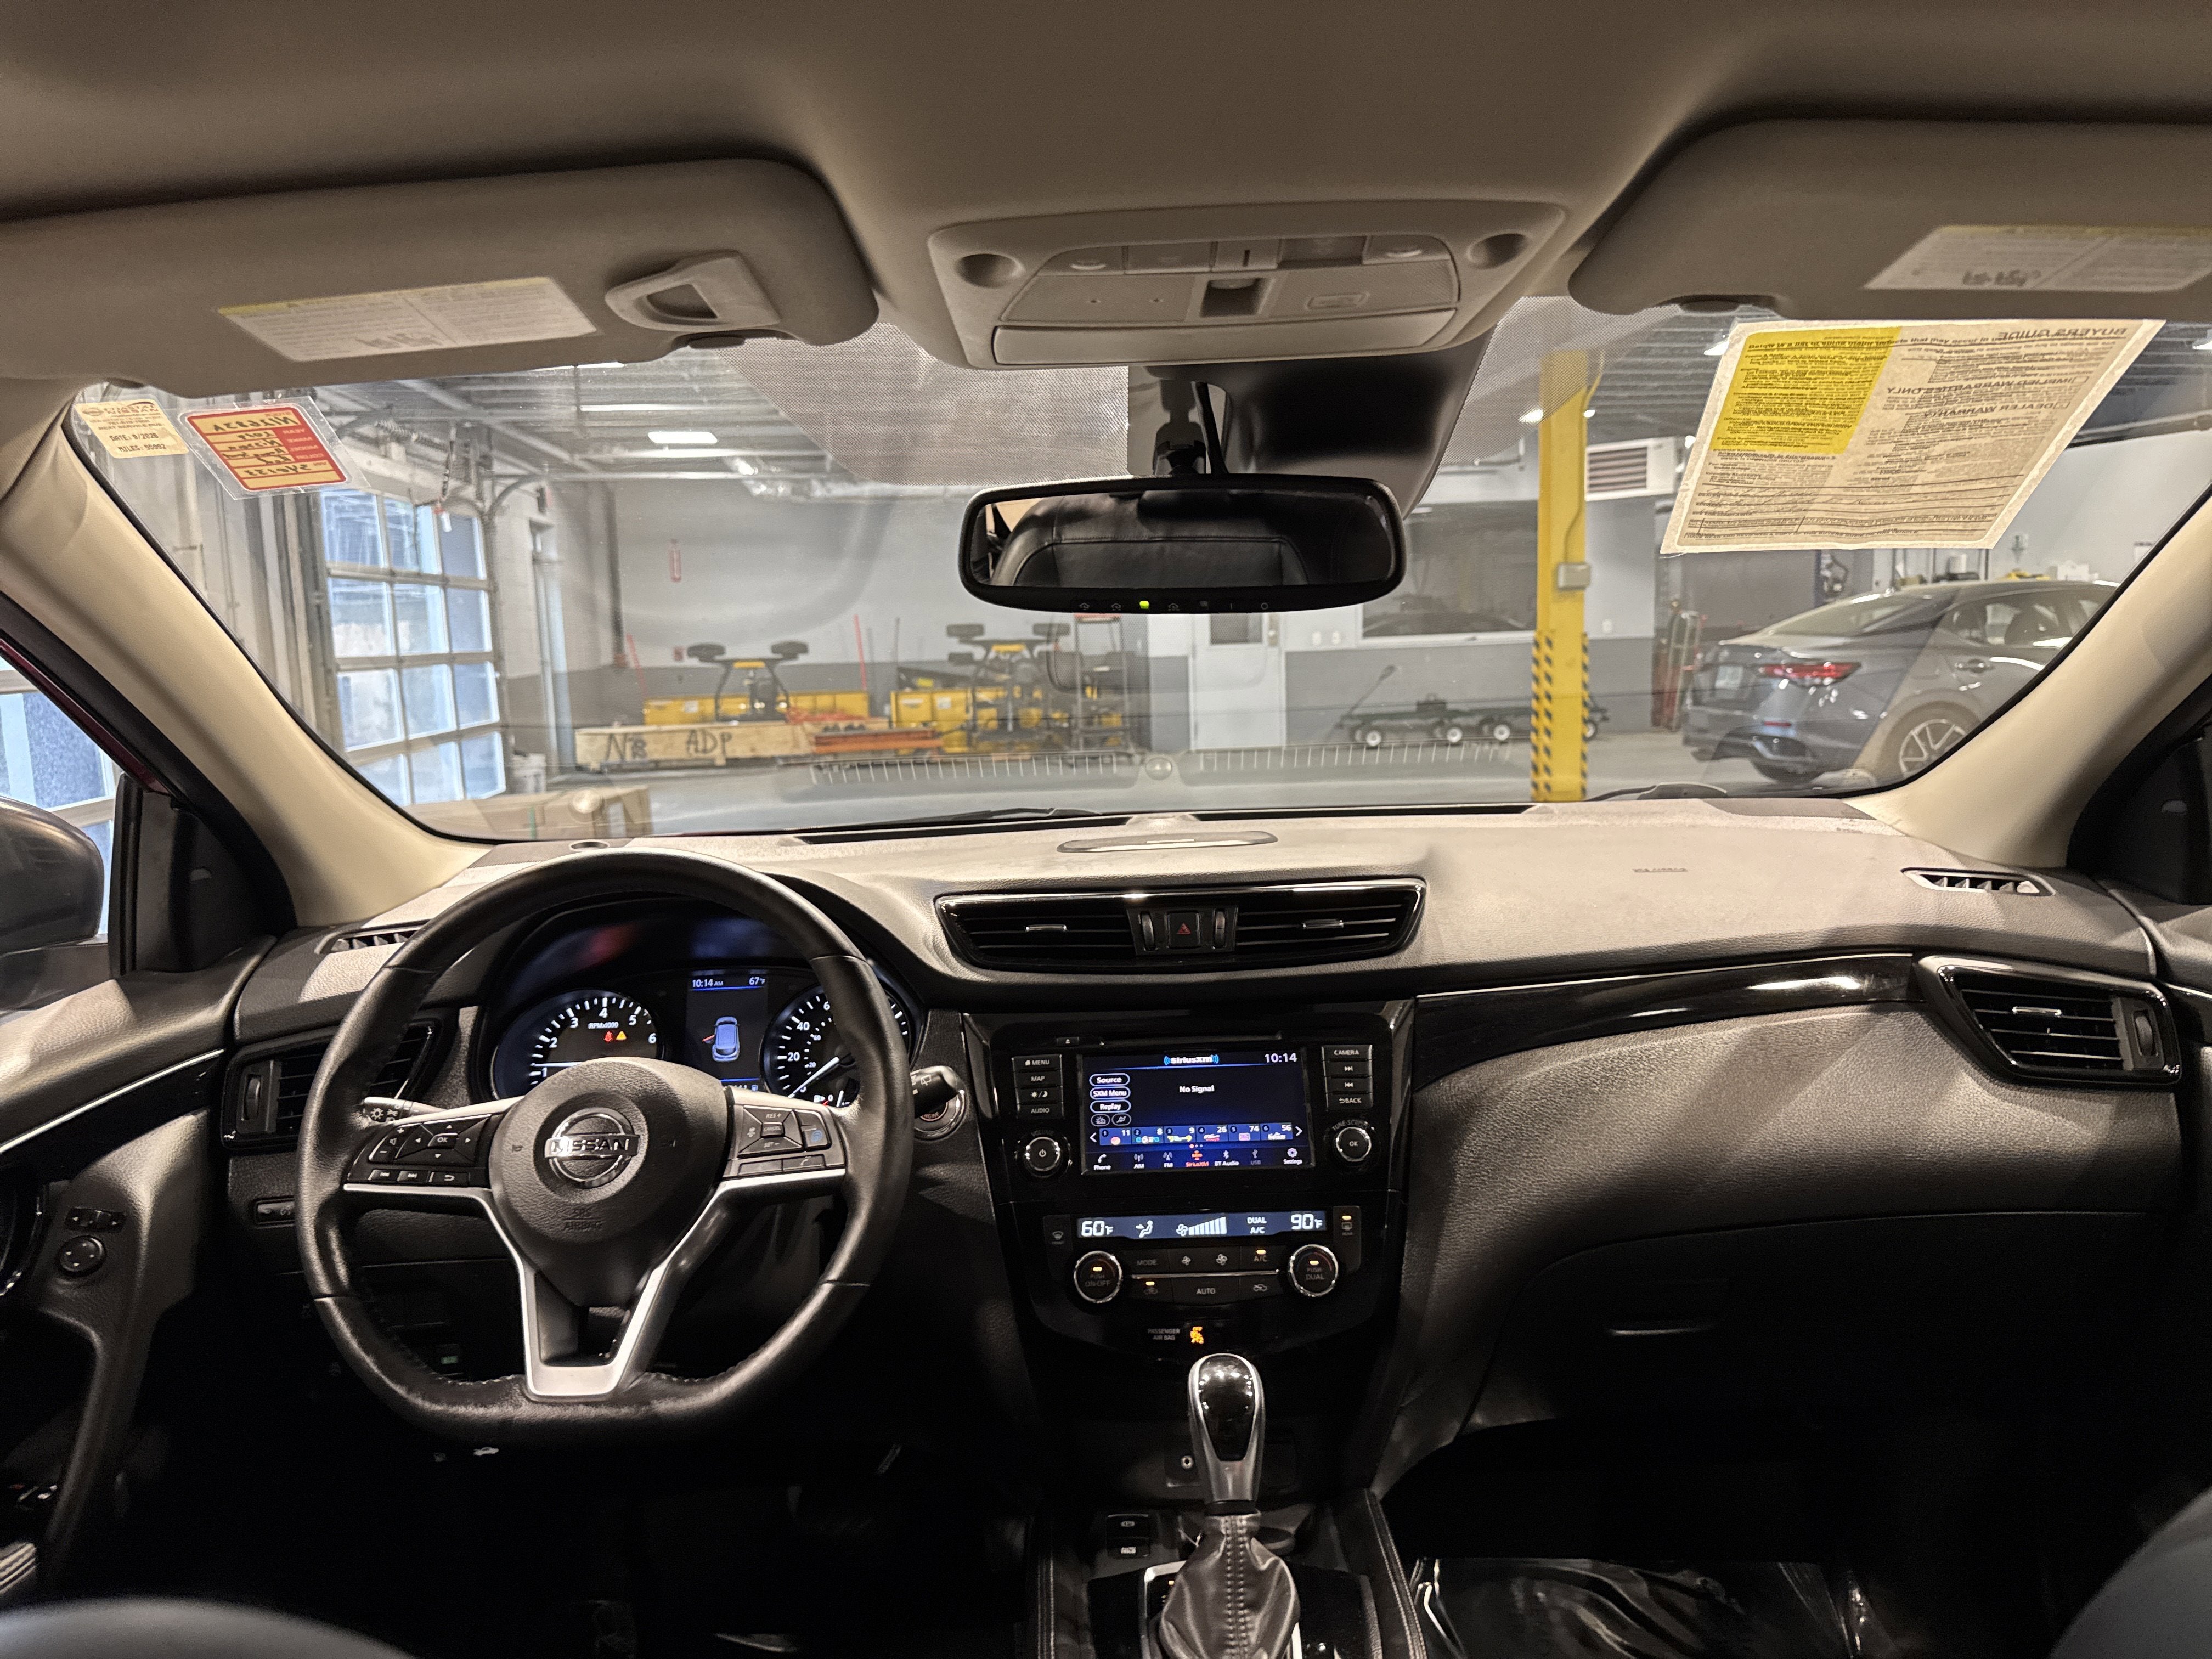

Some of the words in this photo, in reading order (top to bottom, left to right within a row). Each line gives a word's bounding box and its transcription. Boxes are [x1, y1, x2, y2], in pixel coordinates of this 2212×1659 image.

[692, 979, 714, 988] 10:14
[823, 1001, 831, 1011] 6
[599, 1008, 608, 1018] 4
[570, 1017, 579, 1028] 3
[629, 1014, 637, 1025] 5
[797, 1021, 810, 1031] 40
[549, 1037, 558, 1048] 2
[648, 1032, 657, 1044] 6
[787, 1052, 800, 1062] 20
[1264, 1053, 1297, 1063] 10:14
[542, 1067, 547, 1077] 1
[1191, 1085, 1215, 1094] Signal
[1099, 1103, 1122, 1111] Replay
